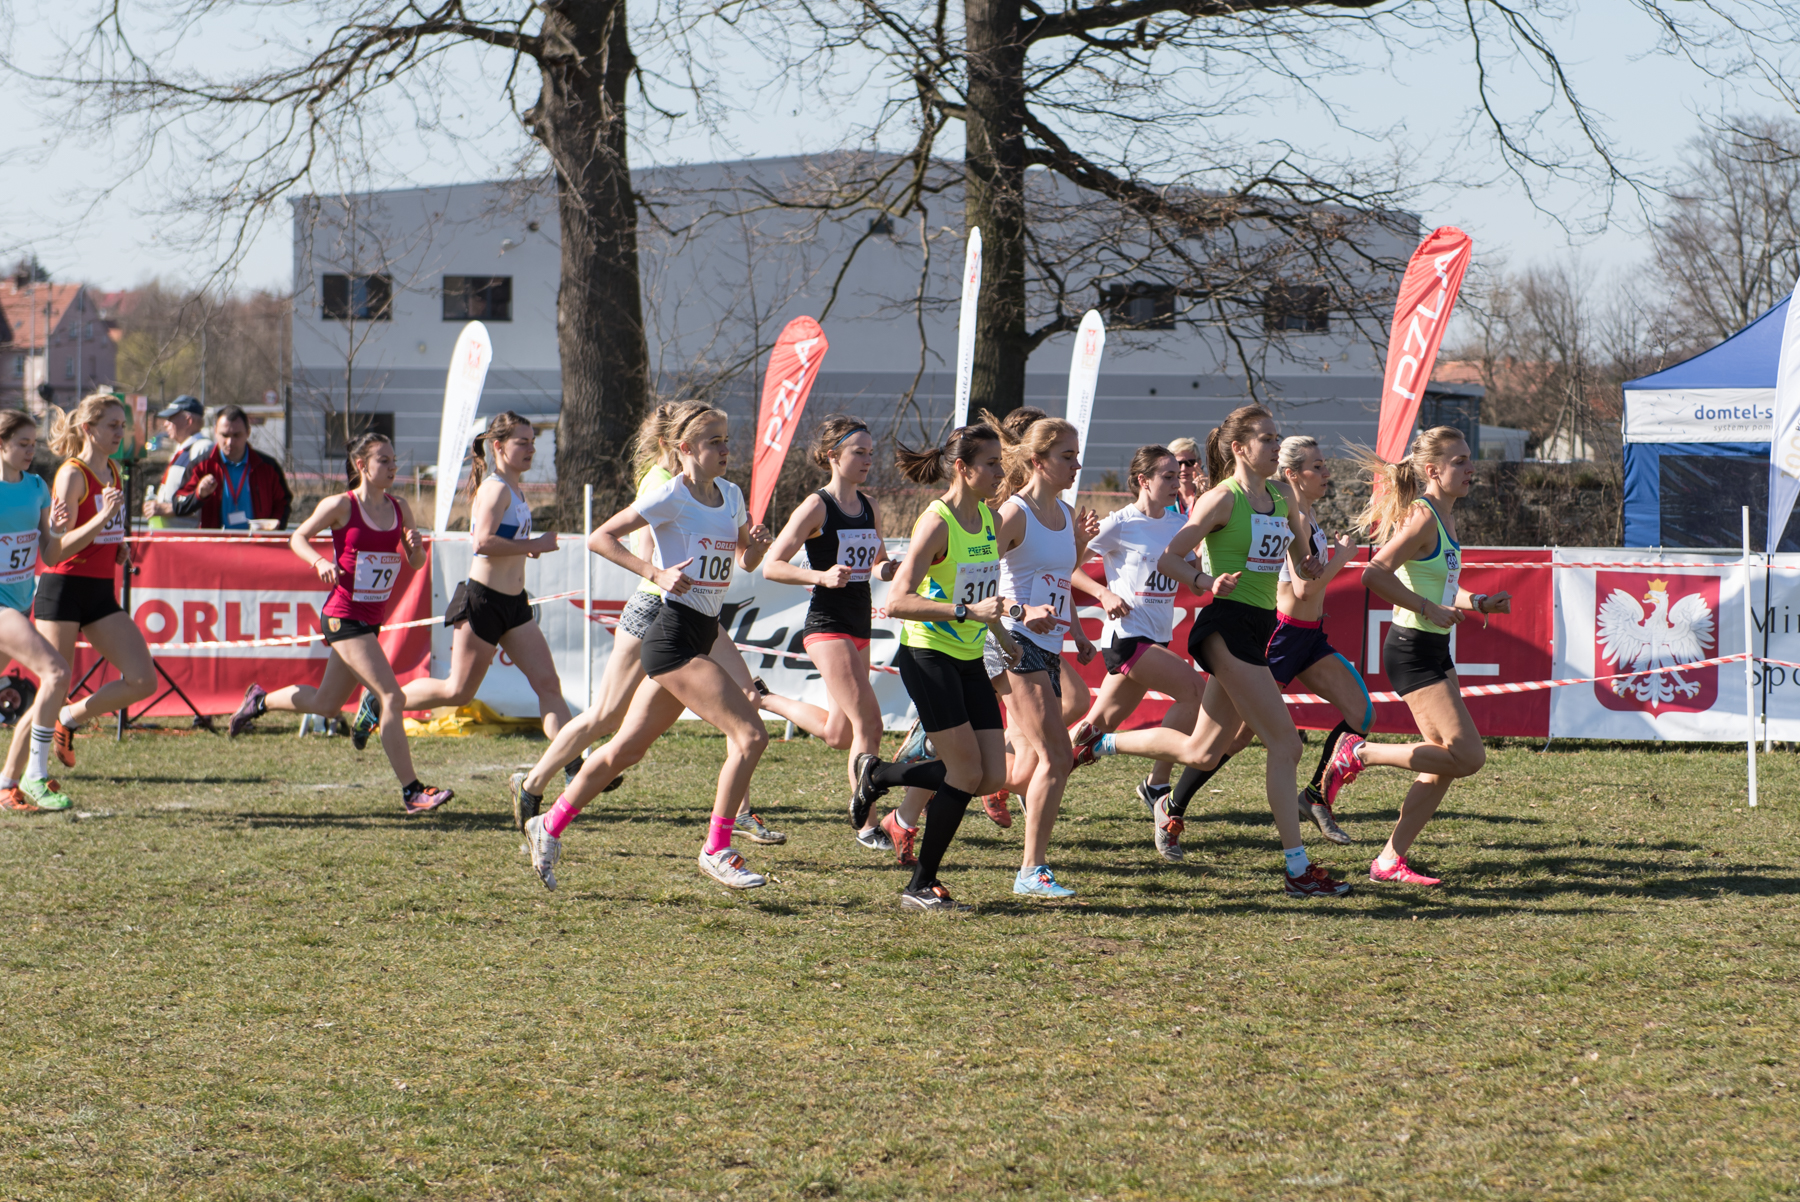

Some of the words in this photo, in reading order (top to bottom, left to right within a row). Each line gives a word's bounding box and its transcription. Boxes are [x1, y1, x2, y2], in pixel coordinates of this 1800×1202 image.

[1392, 246, 1463, 400] PZLA
[763, 337, 819, 452] PZLA
[1713, 424, 1749, 432] systemy
[10, 547, 31, 569] 57
[699, 555, 732, 581] 108
[844, 546, 876, 568] 398
[372, 569, 393, 588] 79
[1144, 570, 1178, 592] 400
[961, 579, 997, 605] 310
[1049, 592, 1065, 618] 11
